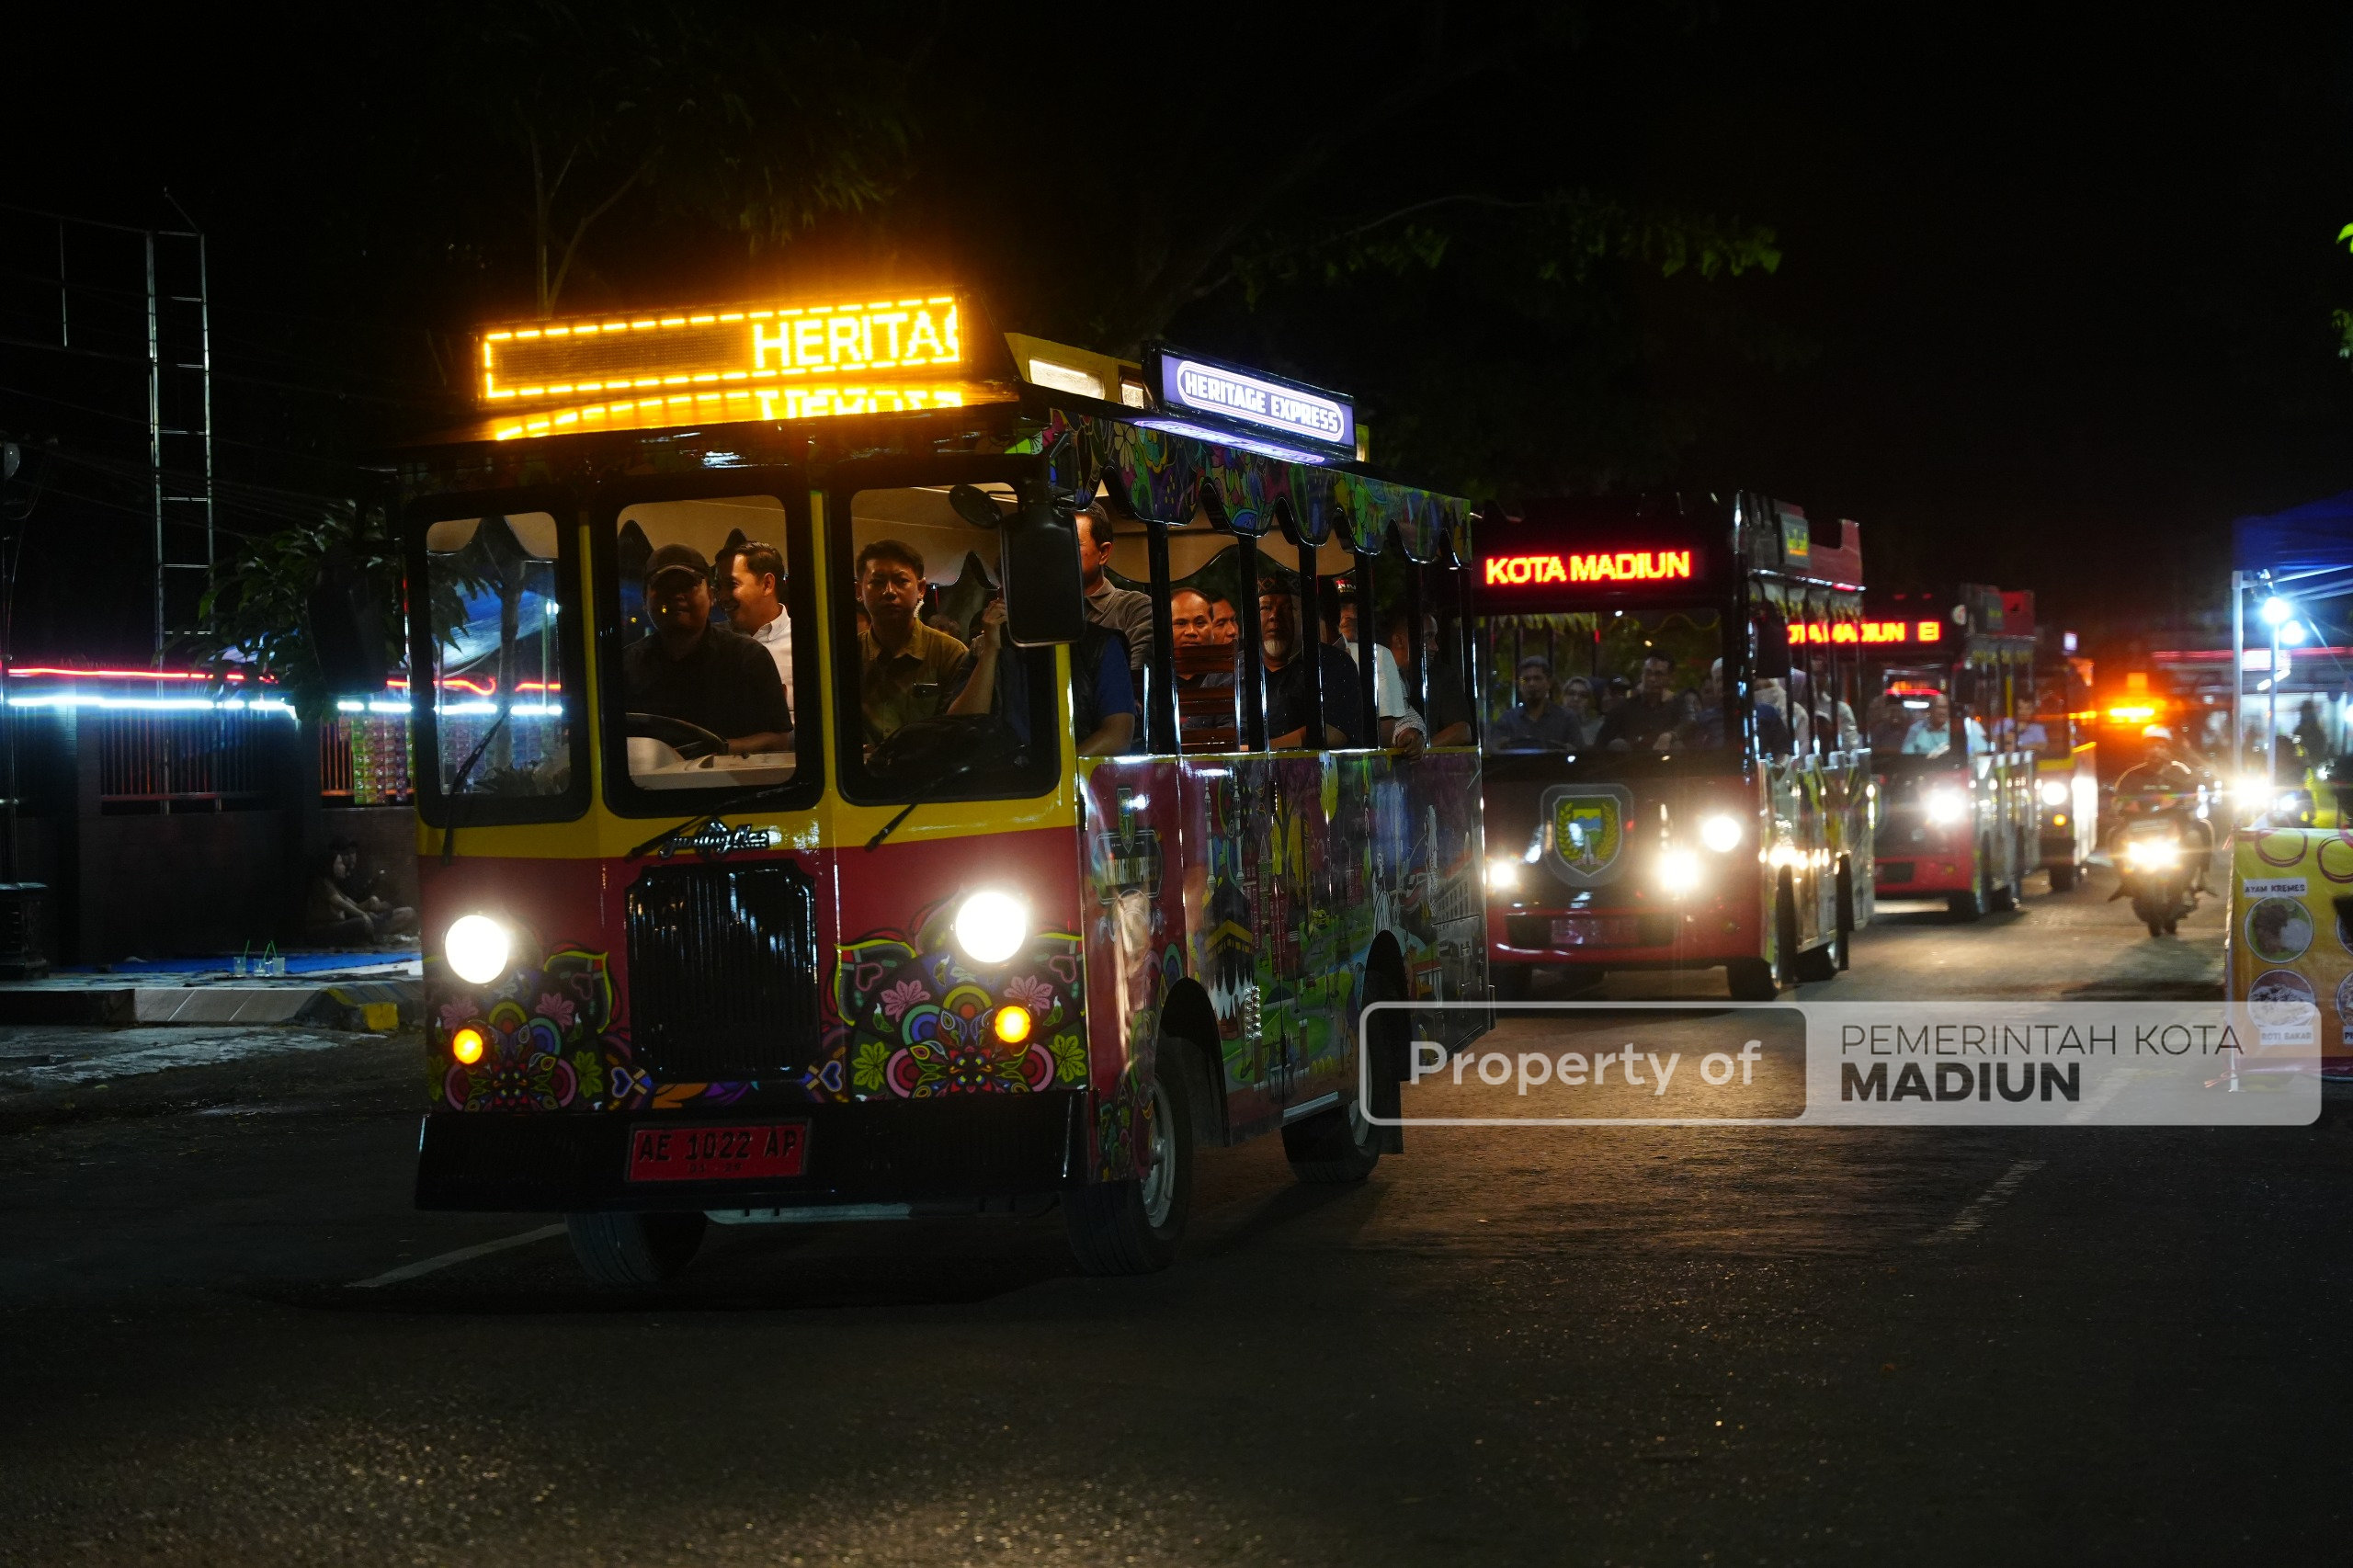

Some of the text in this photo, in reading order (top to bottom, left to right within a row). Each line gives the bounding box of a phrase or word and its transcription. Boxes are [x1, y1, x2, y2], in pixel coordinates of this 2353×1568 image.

[1184, 371, 1338, 433] HERITAGE EXPRESS
[1485, 551, 1690, 585] KOTA MADIUN
[2270, 884, 2305, 892] KREMES
[2260, 1031, 2313, 1040] ROTI BAKAR
[639, 1129, 798, 1162] AE 1022 AP
